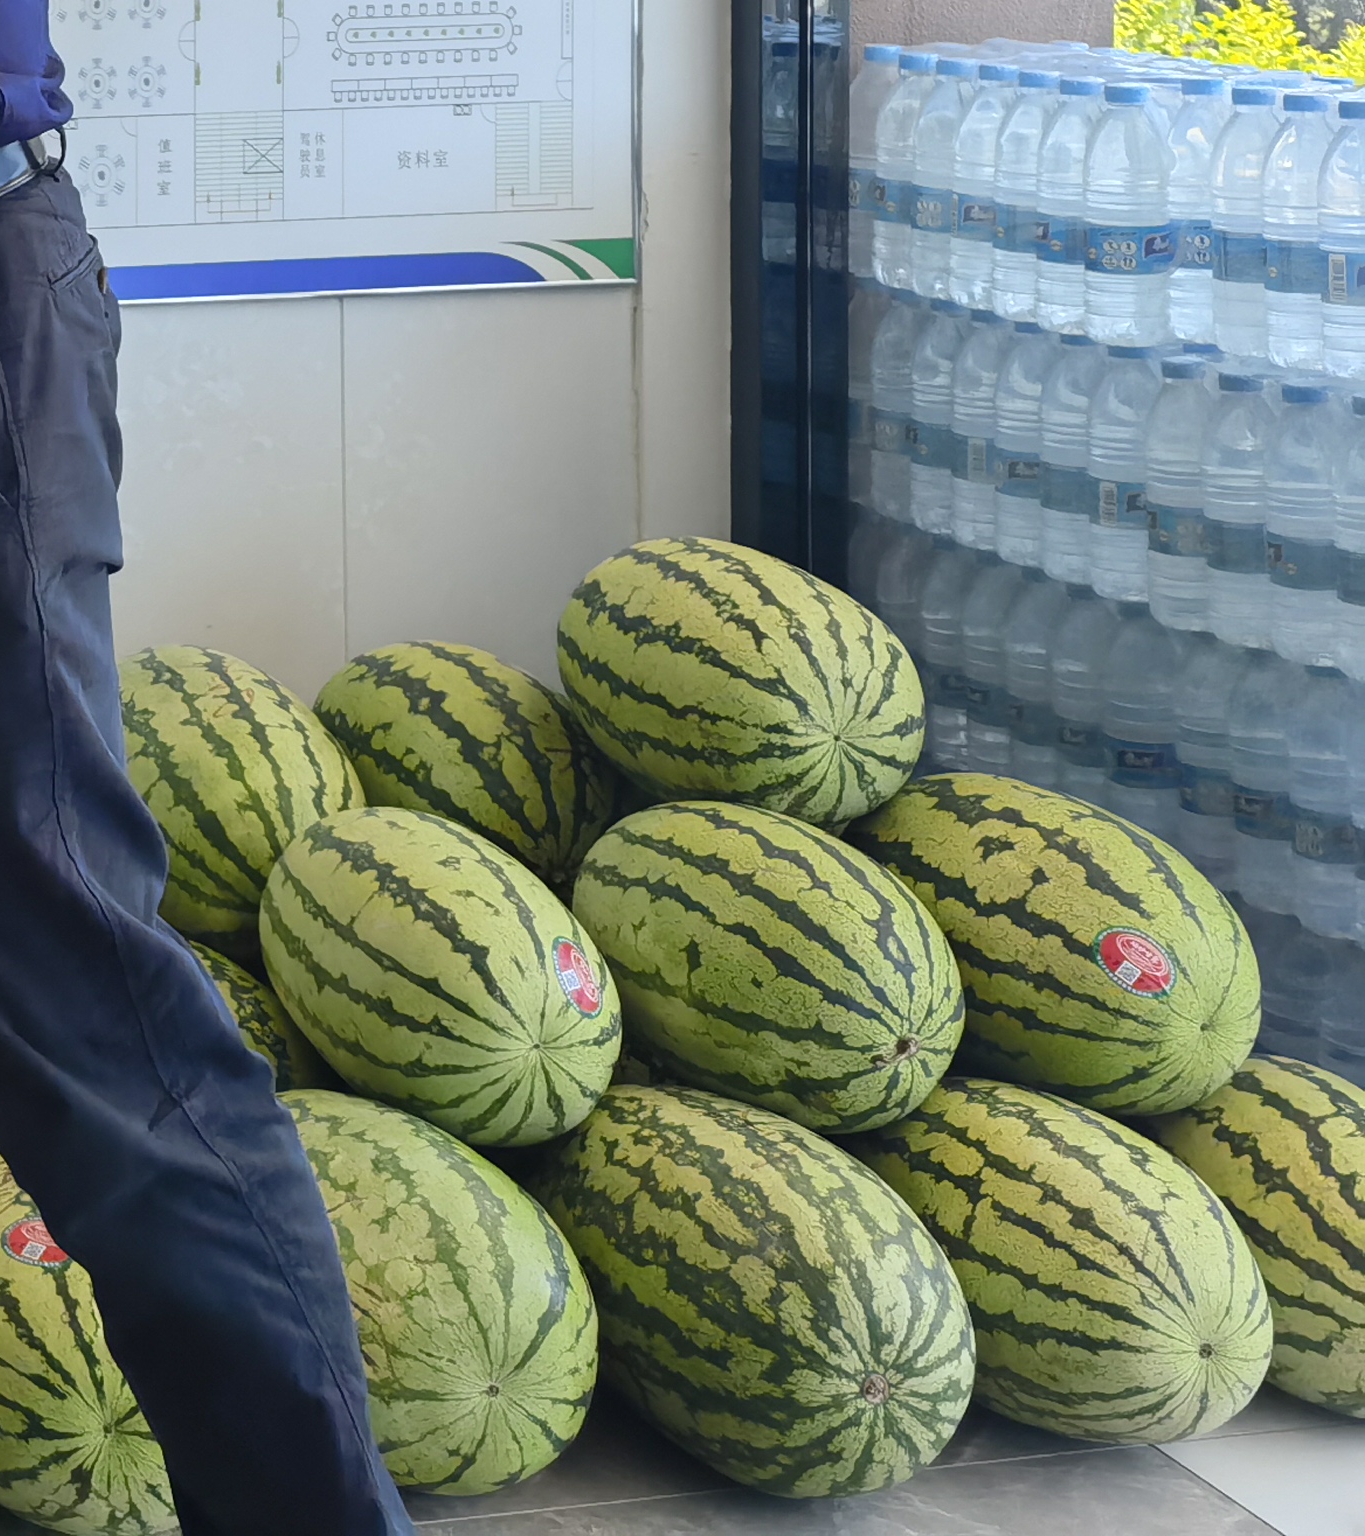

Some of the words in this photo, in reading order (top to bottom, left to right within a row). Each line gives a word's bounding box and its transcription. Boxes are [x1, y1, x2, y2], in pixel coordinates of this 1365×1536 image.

[157, 138, 173, 198] 值班室
[396, 148, 450, 170] 资料室
